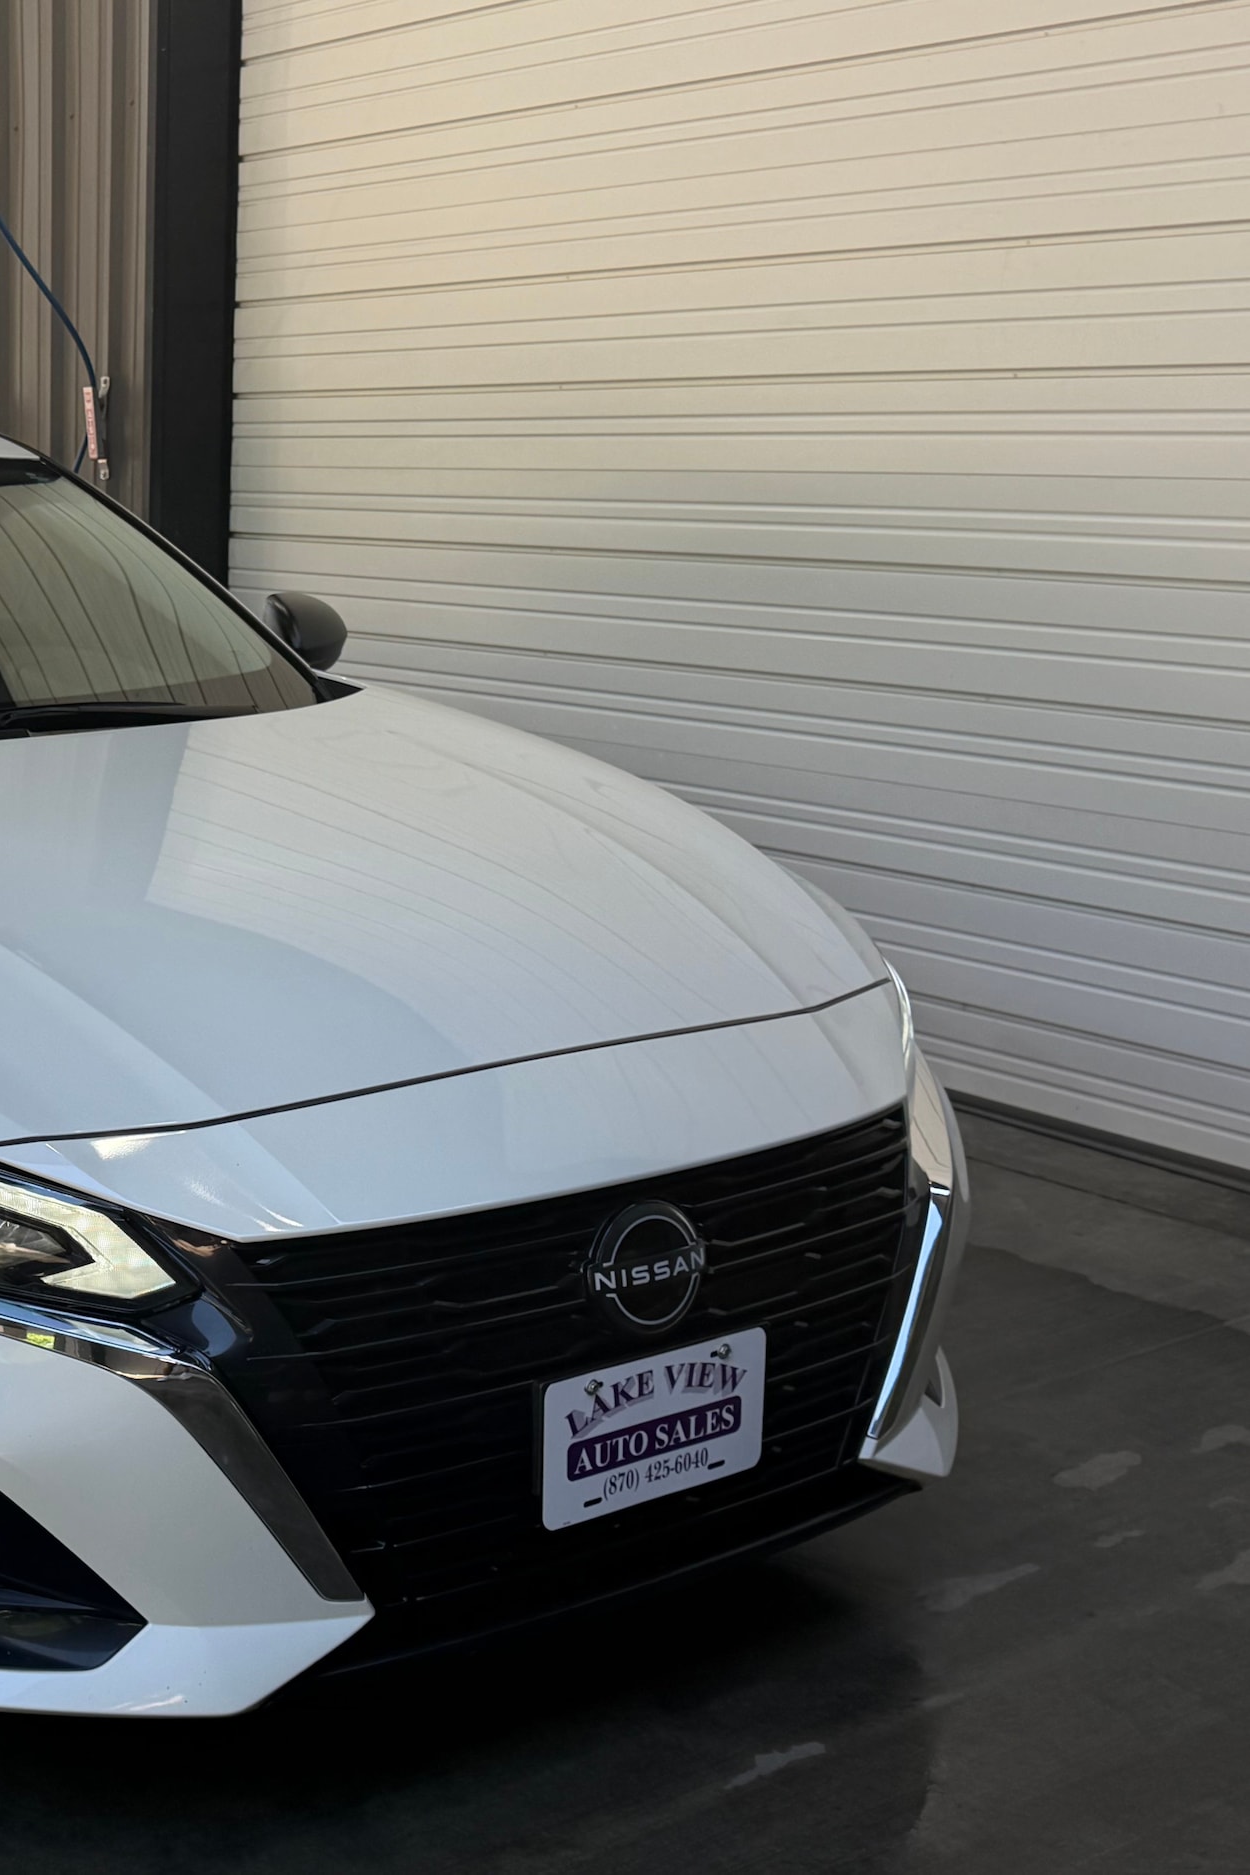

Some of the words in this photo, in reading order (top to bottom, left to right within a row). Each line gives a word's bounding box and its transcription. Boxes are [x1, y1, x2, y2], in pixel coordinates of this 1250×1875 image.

[594, 1251, 705, 1291] NISSAN
[564, 1370, 655, 1438] LAKE
[664, 1362, 748, 1395] VIEW
[573, 1430, 649, 1475] AUTO
[655, 1403, 735, 1450] SALES
[603, 1469, 640, 1501] (870)
[644, 1447, 709, 1483] 425-6040
